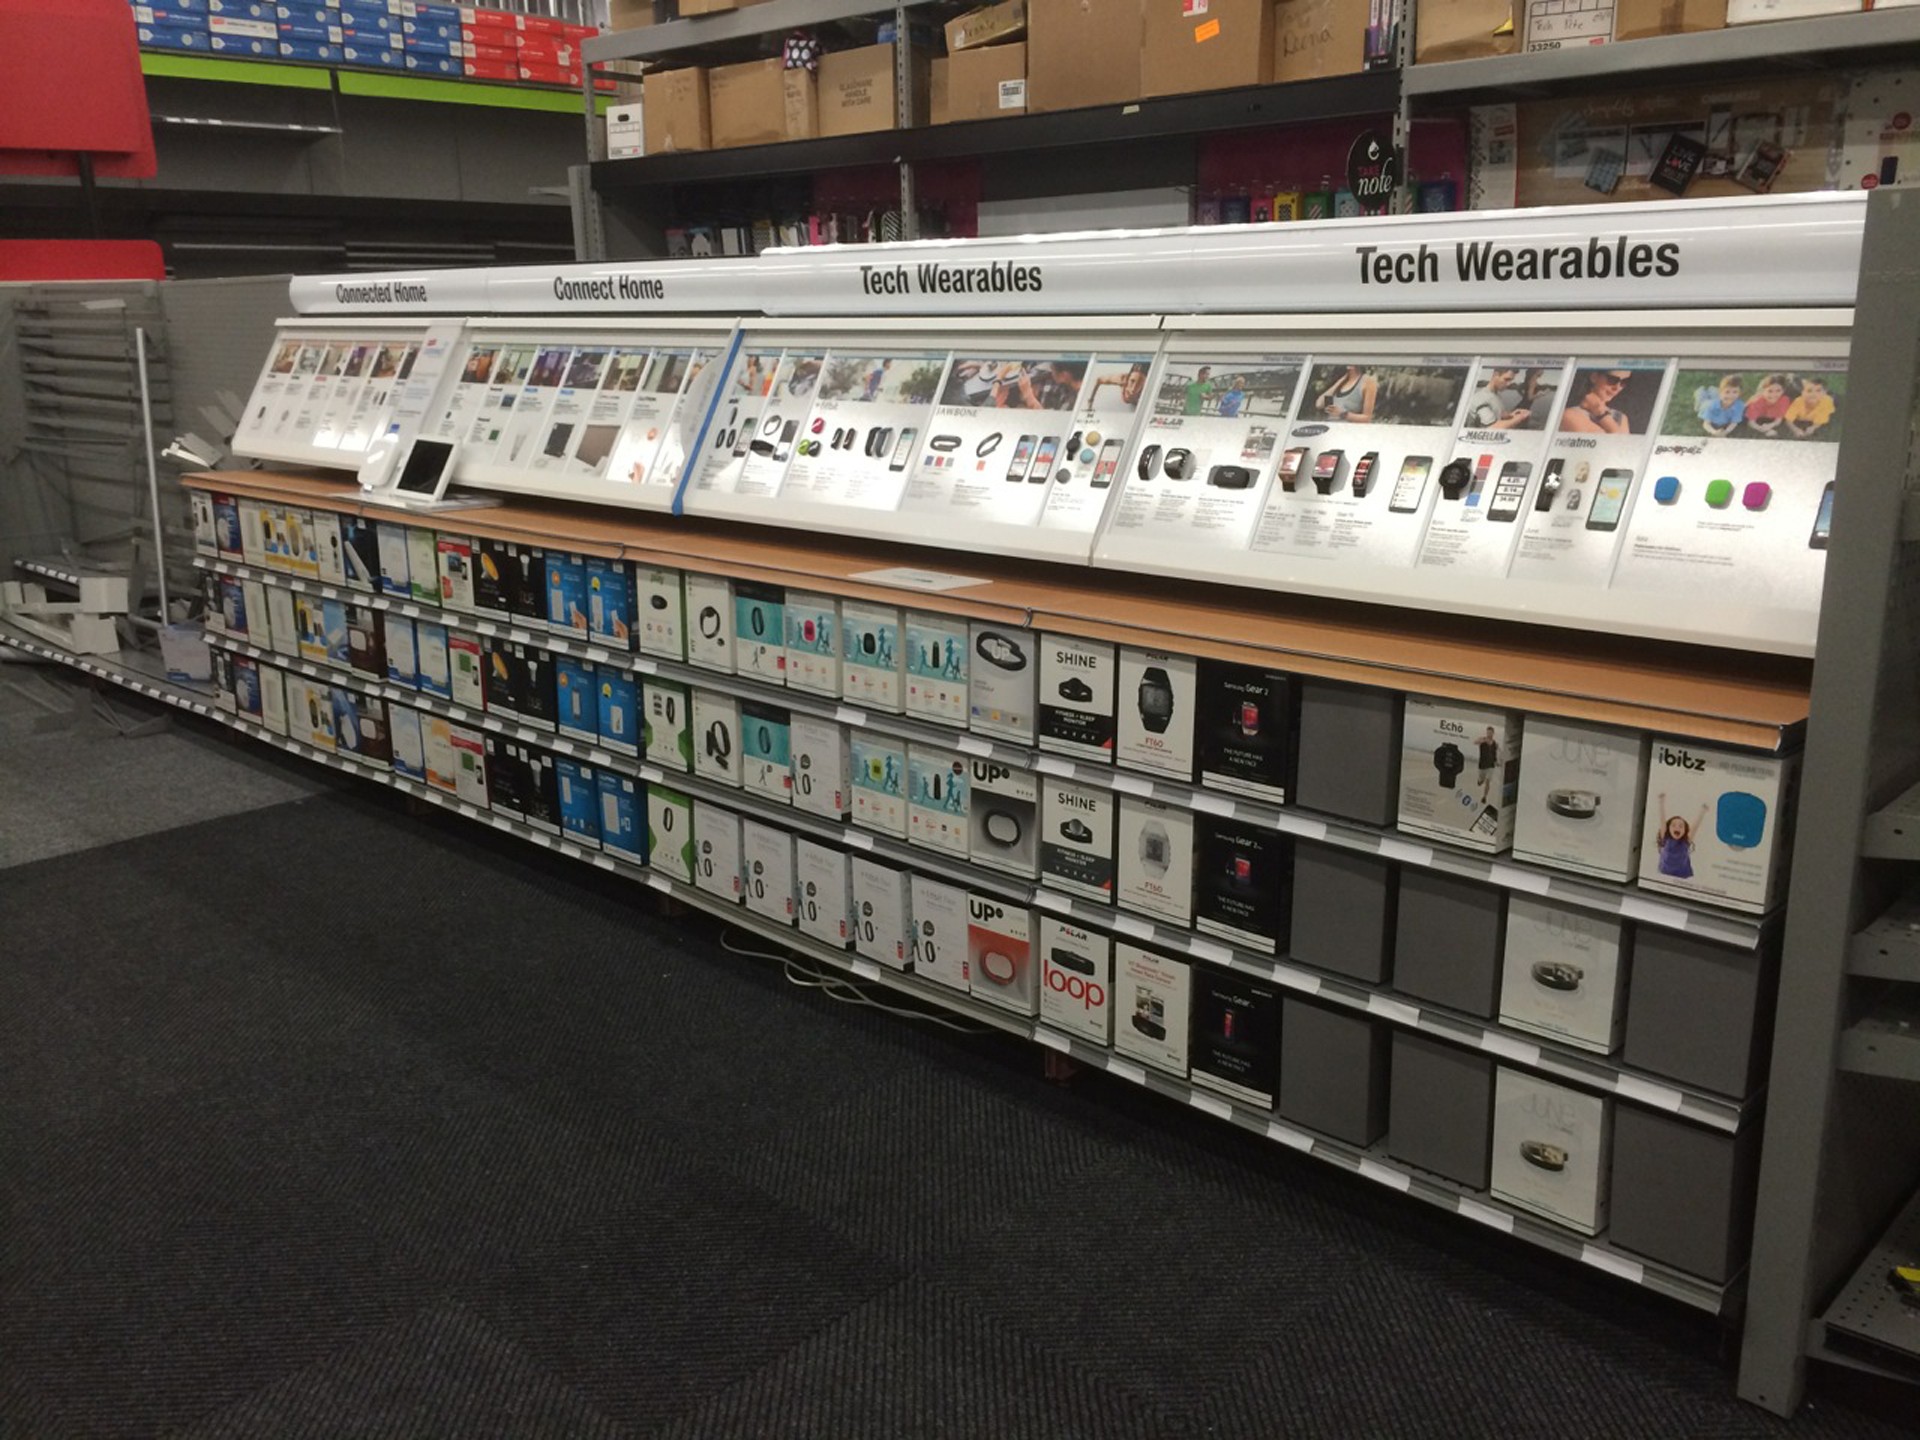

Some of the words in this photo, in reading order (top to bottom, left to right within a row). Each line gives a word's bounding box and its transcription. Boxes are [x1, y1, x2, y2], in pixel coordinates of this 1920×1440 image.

[1530, 42, 1561, 53] 33250
[1358, 157, 1393, 196] note
[1356, 244, 1439, 284] Tech
[1456, 236, 1680, 282] Wearables
[860, 265, 910, 294] Tech
[918, 260, 1042, 293] Wearables
[335, 282, 391, 304] Connected
[394, 281, 427, 302] Home
[553, 276, 614, 301] Connect
[618, 275, 664, 300] Home
[1465, 431, 1505, 441] MAGELLAN
[1554, 437, 1597, 448] netatmo
[1056, 651, 1097, 668] SHINE
[1245, 683, 1263, 695] Gear
[1440, 720, 1464, 733] Echo
[1658, 747, 1707, 772] ibitz
[1058, 792, 1097, 812] SHINE
[1235, 836, 1252, 847] Gear
[1059, 925, 1088, 941] POLAR
[1043, 959, 1105, 1010] loop
